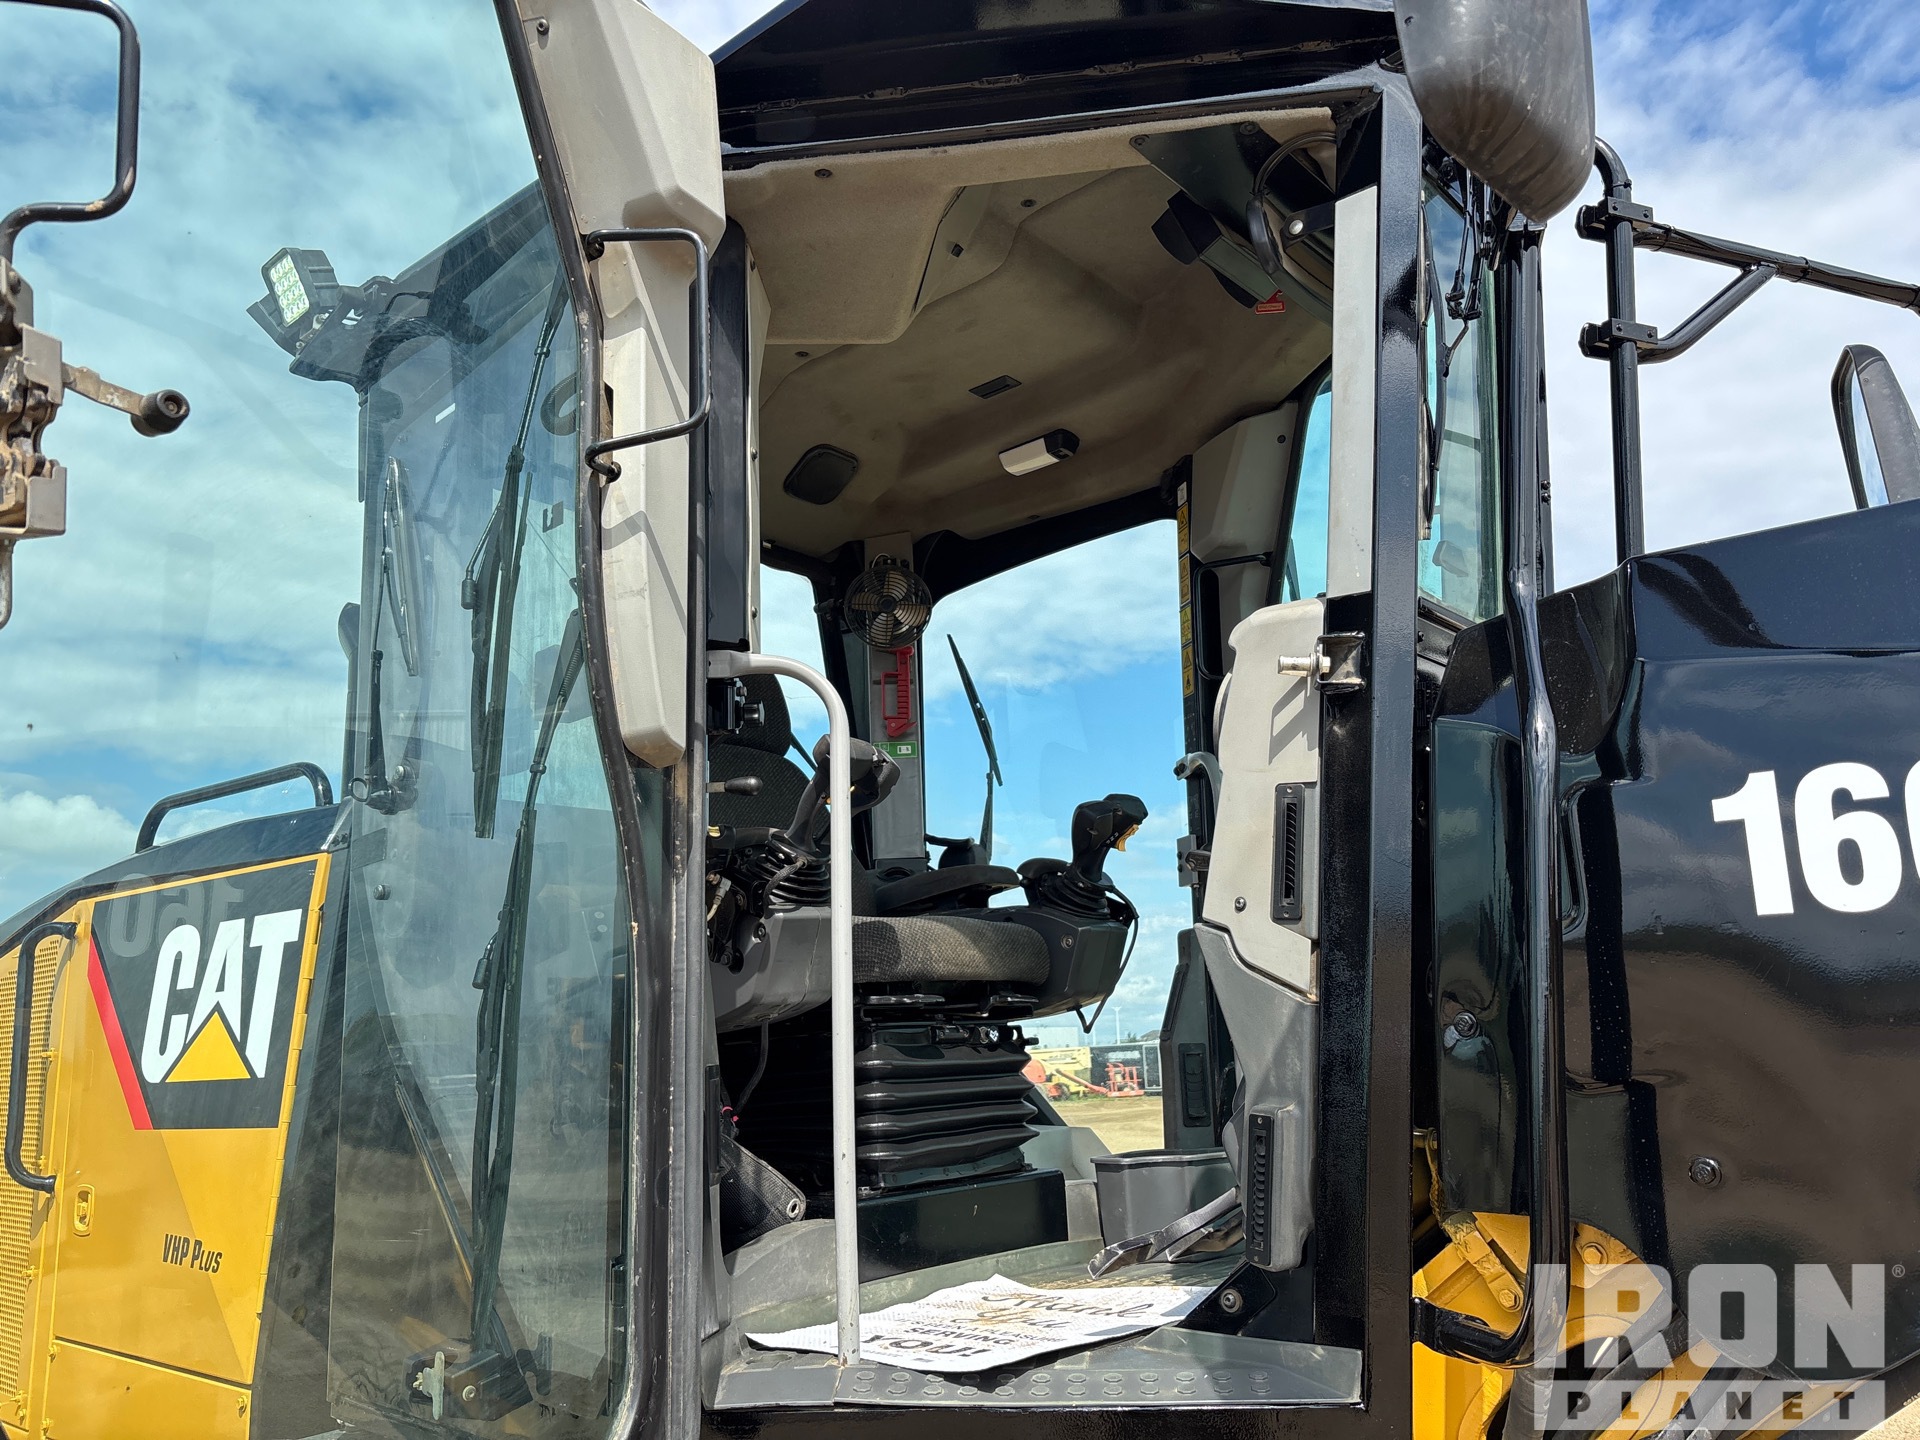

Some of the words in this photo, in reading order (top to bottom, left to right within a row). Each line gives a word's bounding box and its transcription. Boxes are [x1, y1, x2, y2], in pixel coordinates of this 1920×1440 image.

[1711, 760, 1920, 916] 16
[141, 908, 303, 1084] CAT
[162, 1233, 191, 1266] VHP
[861, 1334, 992, 1357] YOU!
[904, 1327, 1016, 1345] SERVING
